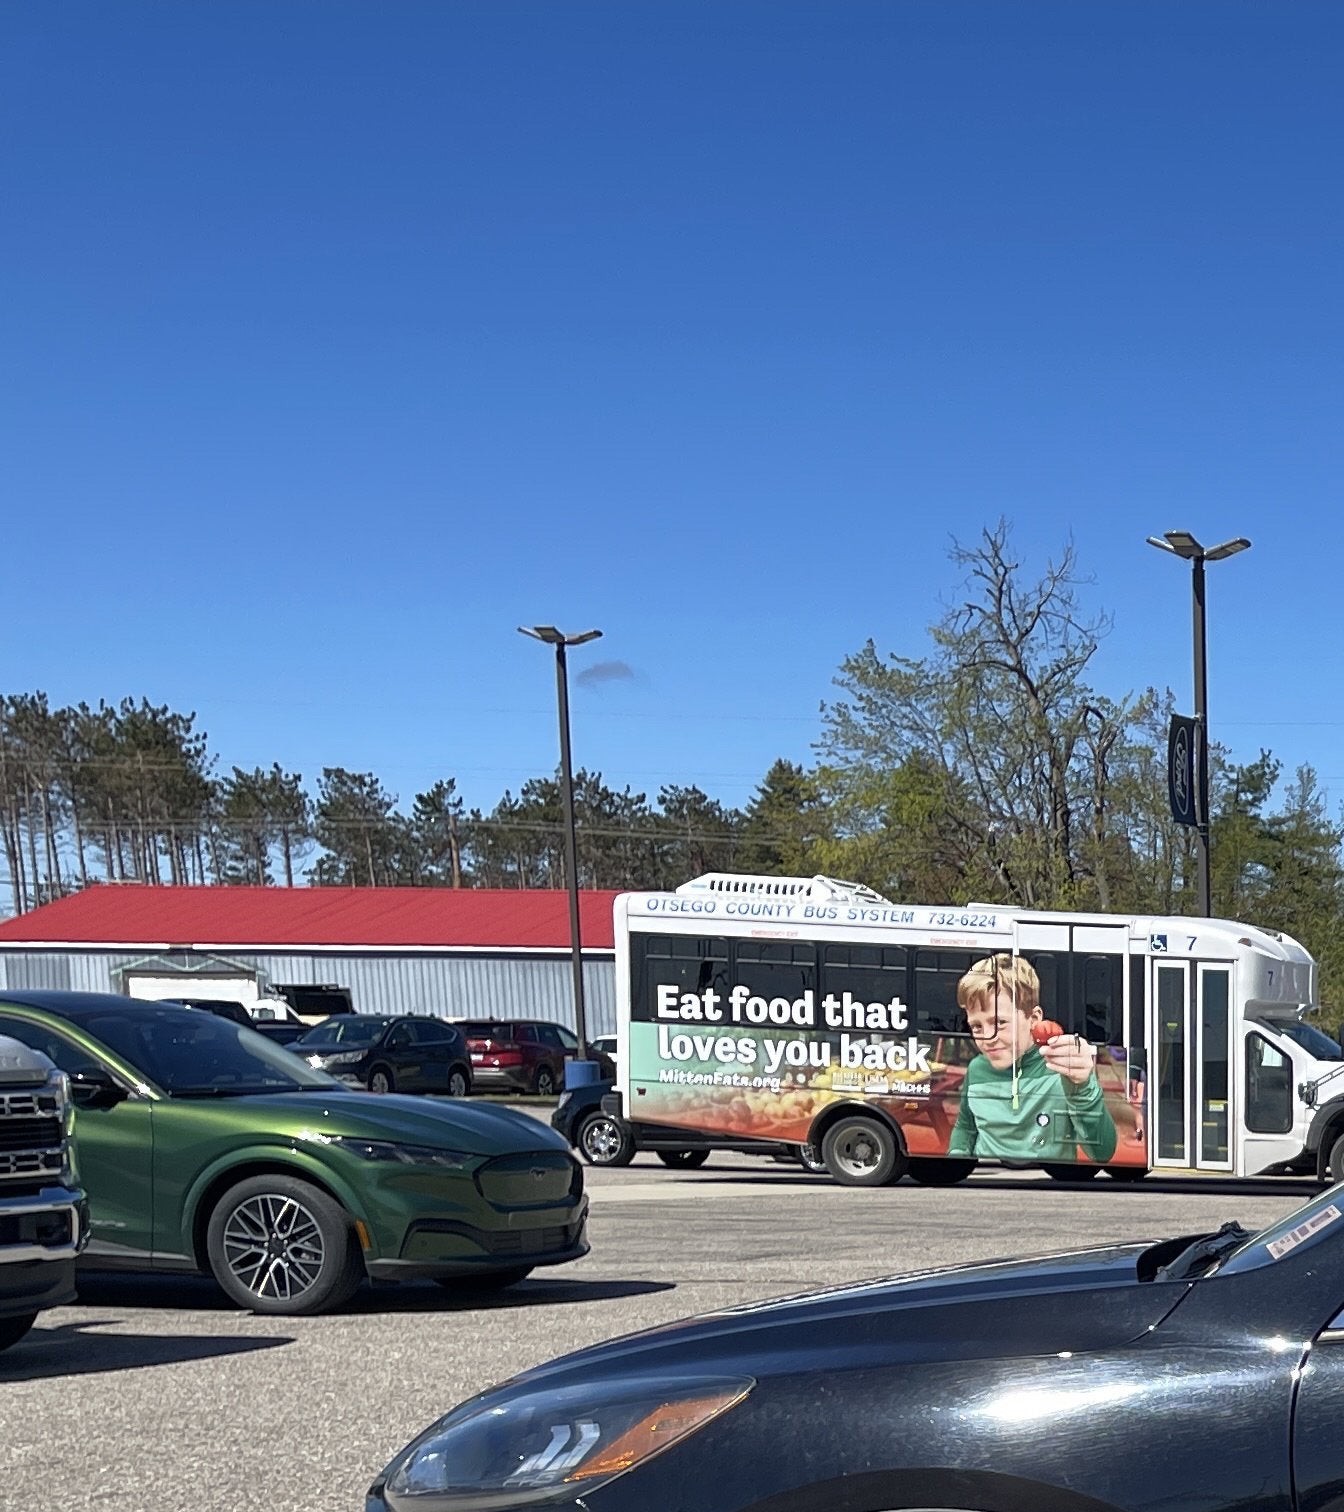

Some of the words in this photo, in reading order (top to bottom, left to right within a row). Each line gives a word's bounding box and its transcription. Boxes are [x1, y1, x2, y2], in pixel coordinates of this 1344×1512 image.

[1176, 742, 1187, 799] Ford
[647, 898, 717, 914] OTSEGO
[726, 902, 796, 917] COUNTY
[804, 905, 838, 919] BUS
[847, 907, 915, 923] SYSTEM
[928, 912, 997, 927] 732-6224
[1186, 936, 1198, 951] 7
[1267, 971, 1274, 987] 7
[657, 984, 723, 1021] Eat
[728, 985, 814, 1026] food
[821, 990, 909, 1030] that
[658, 1025, 757, 1064] loves
[764, 1039, 831, 1074] you
[840, 1033, 931, 1073] back
